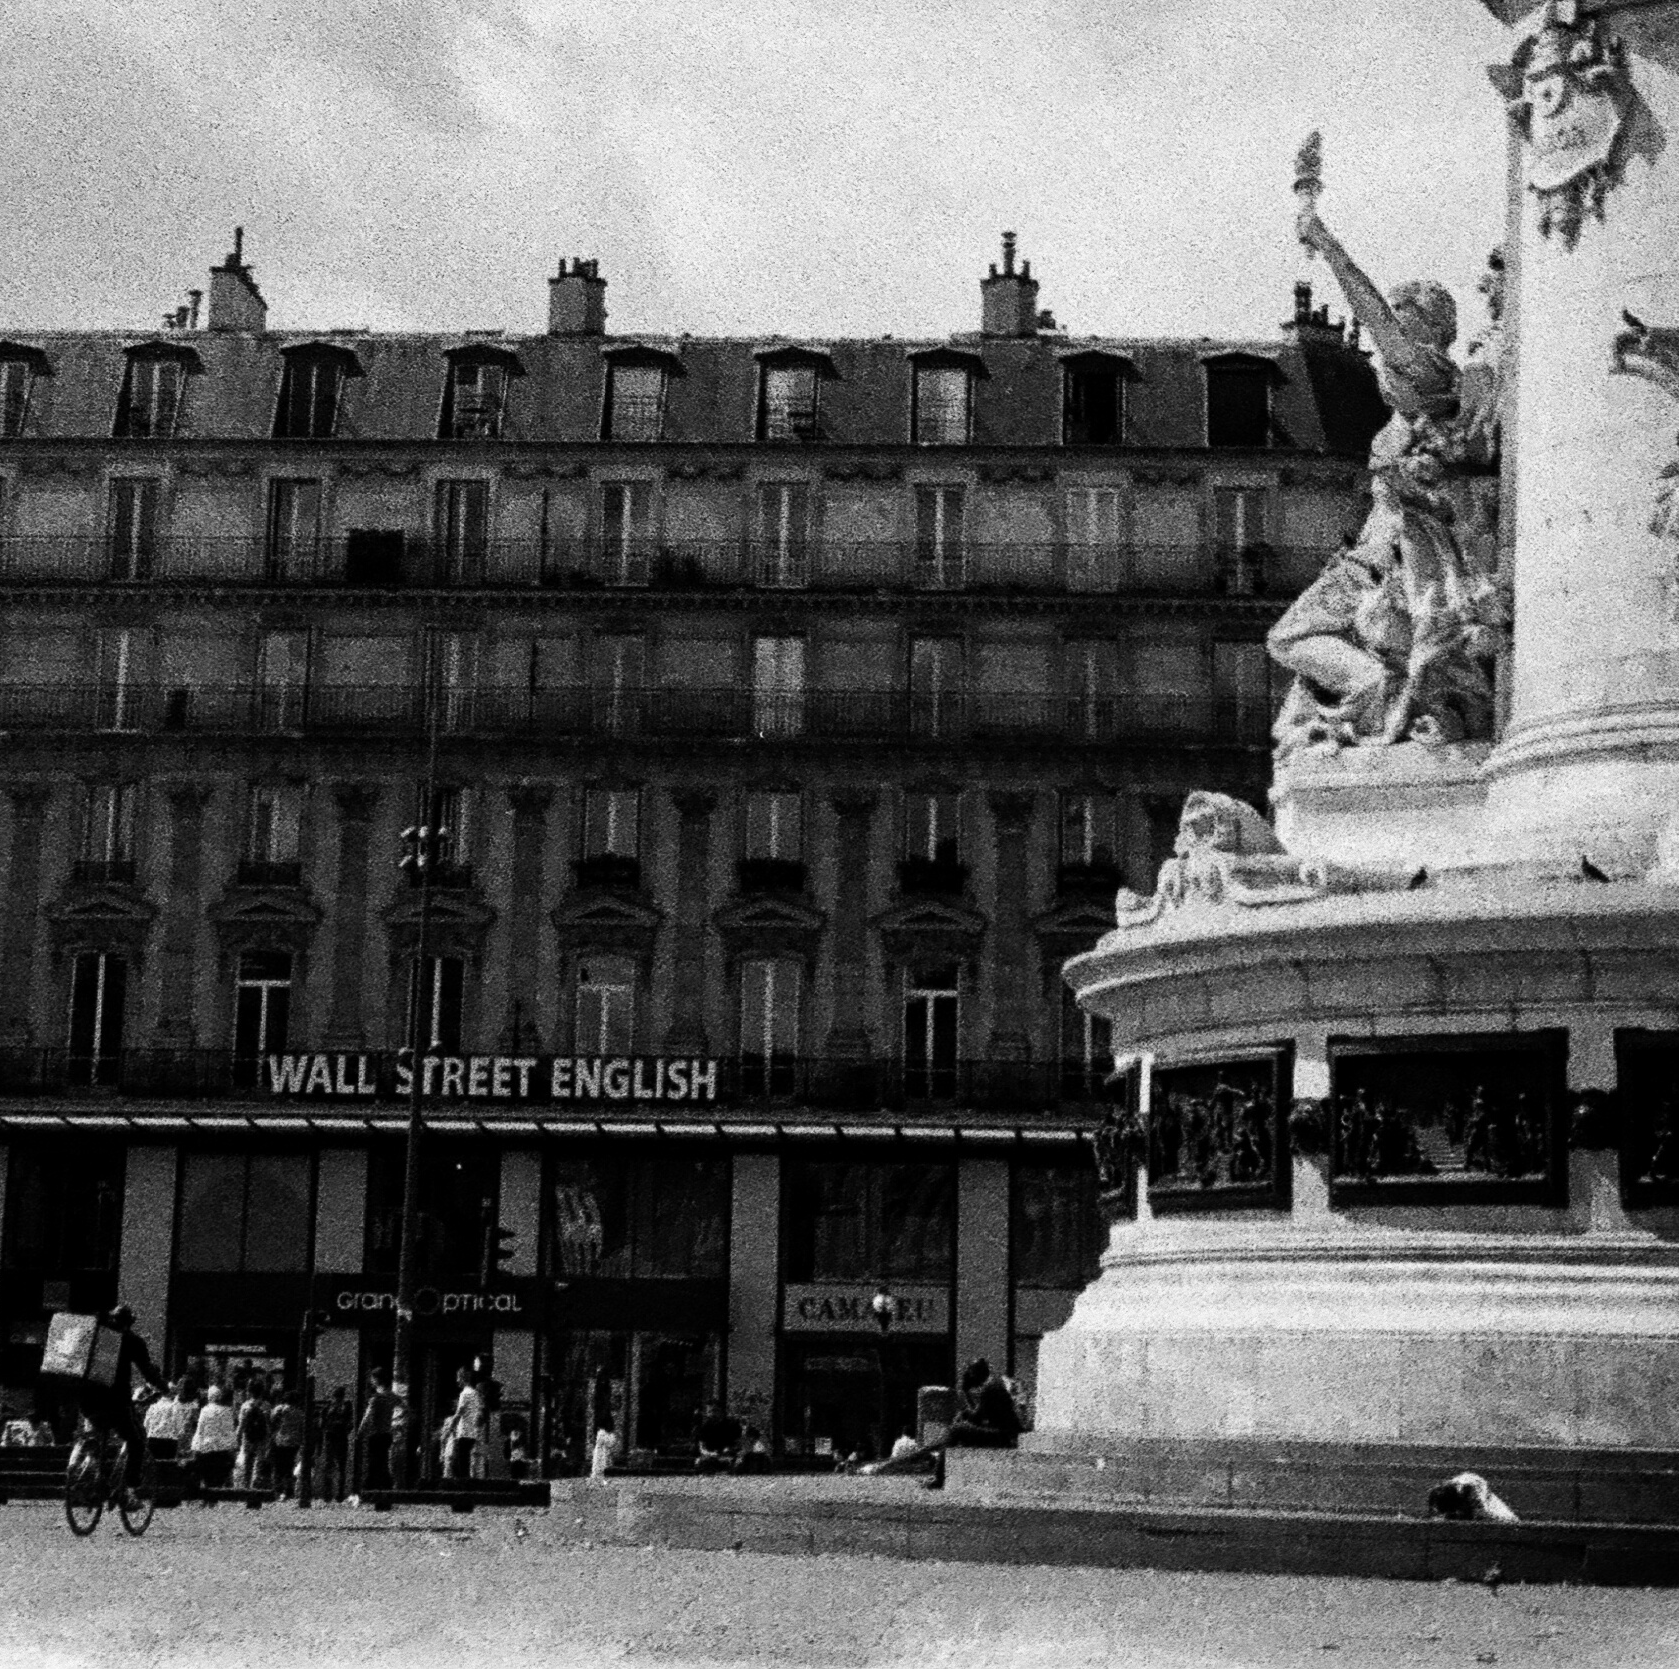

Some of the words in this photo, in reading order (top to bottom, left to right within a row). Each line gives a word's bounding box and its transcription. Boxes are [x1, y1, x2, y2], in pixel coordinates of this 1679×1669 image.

[267, 1052, 377, 1094] WALL
[394, 1054, 538, 1097] STREET
[549, 1057, 719, 1101] ENGLISH
[798, 1297, 935, 1323] CAMAEU
